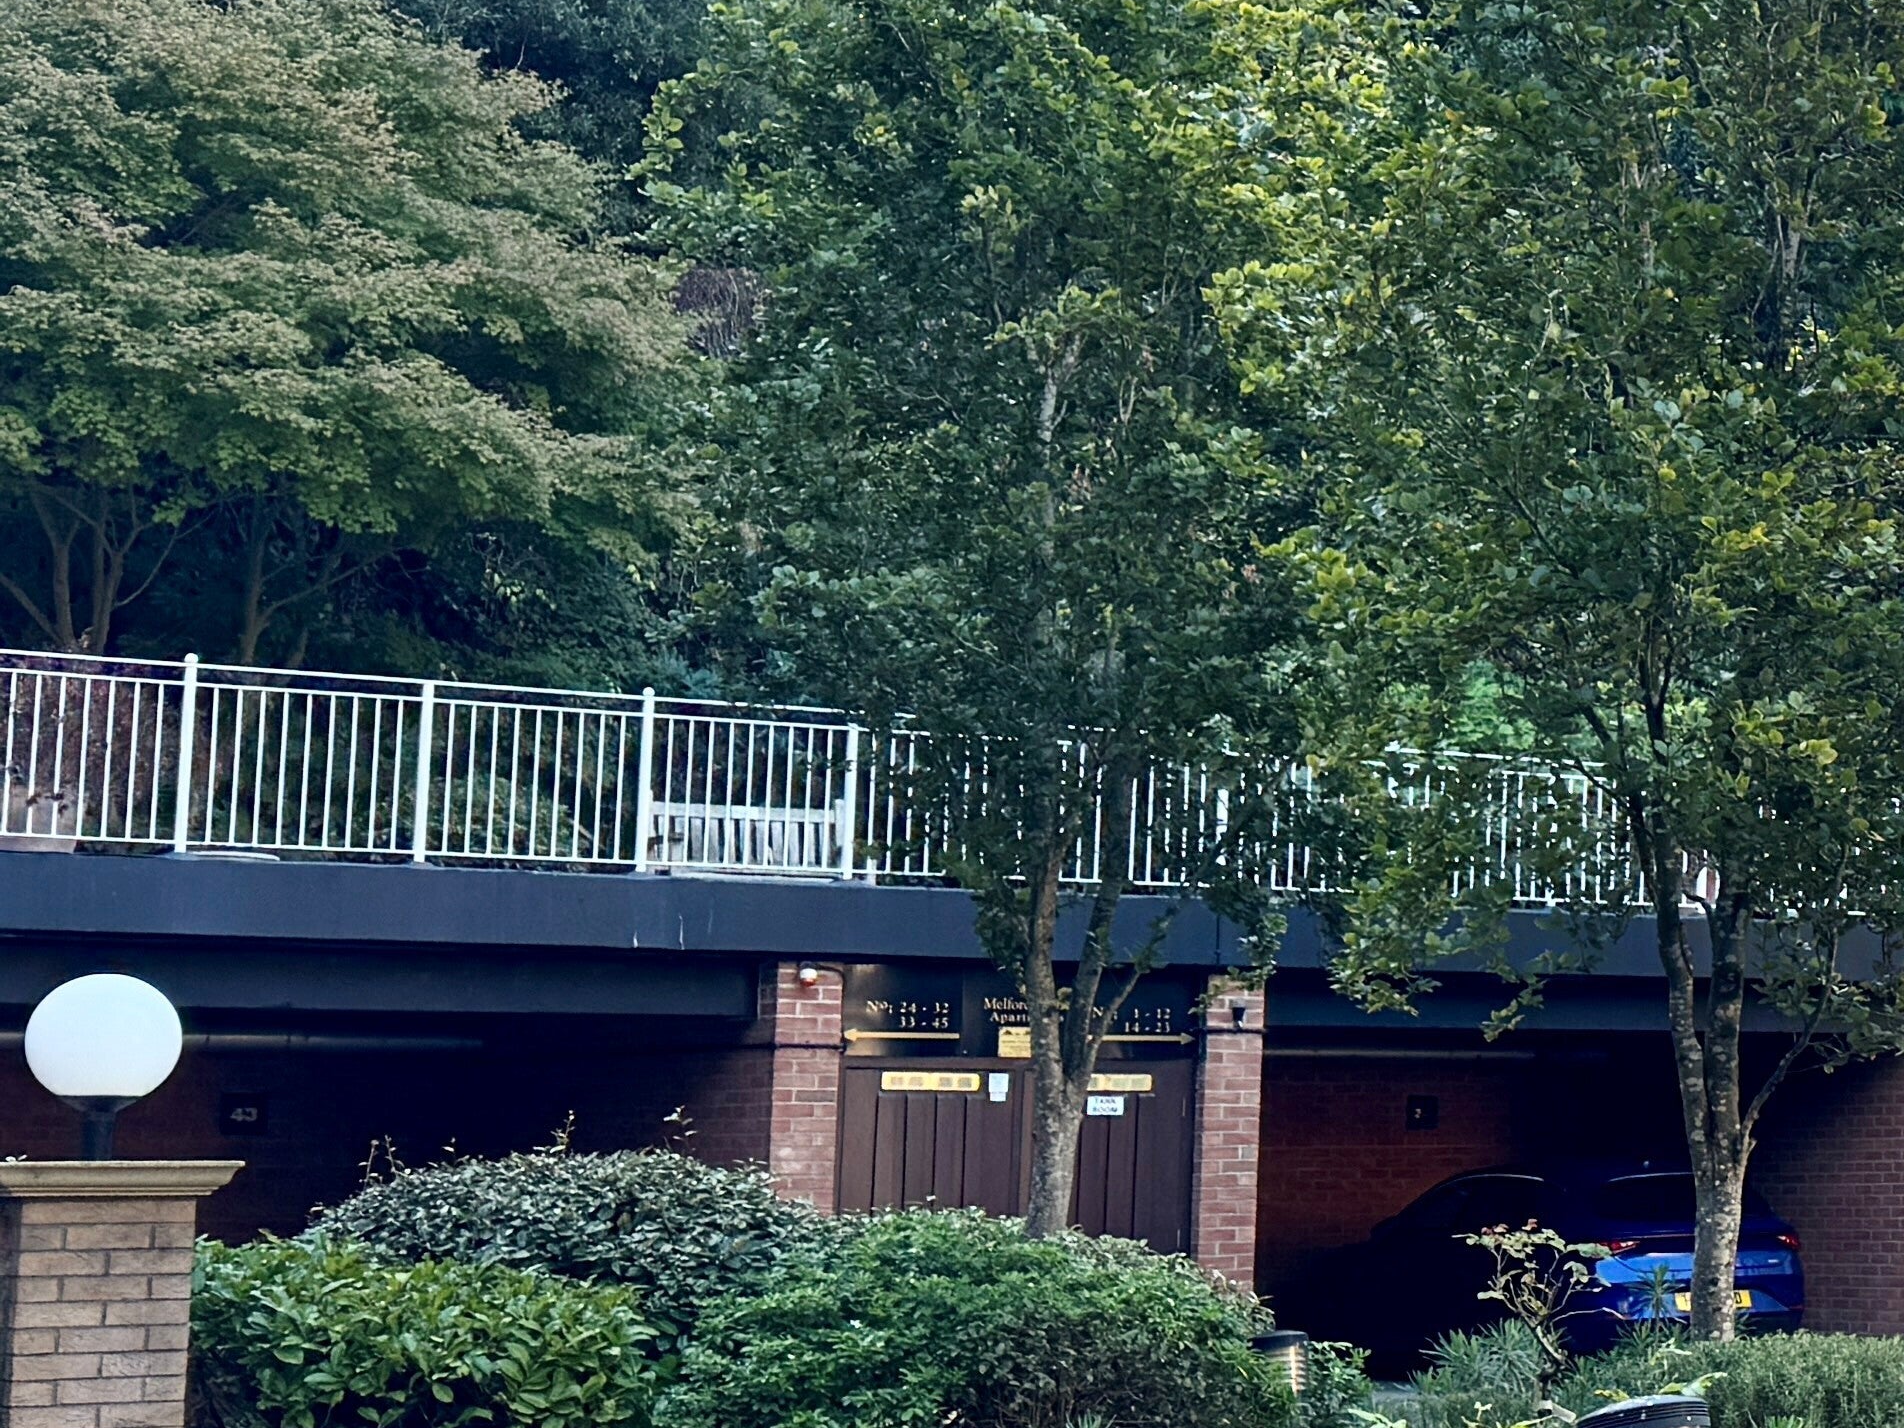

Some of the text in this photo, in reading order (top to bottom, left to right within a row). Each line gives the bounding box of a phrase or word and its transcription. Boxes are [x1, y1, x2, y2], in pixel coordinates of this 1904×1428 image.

[900, 1001, 916, 1013] 24
[1134, 1008, 1139, 1019] 1
[1157, 1008, 1171, 1019] 12
[899, 1016, 916, 1029] 33
[932, 1017, 949, 1029] 45
[1125, 1022, 1139, 1033] 14
